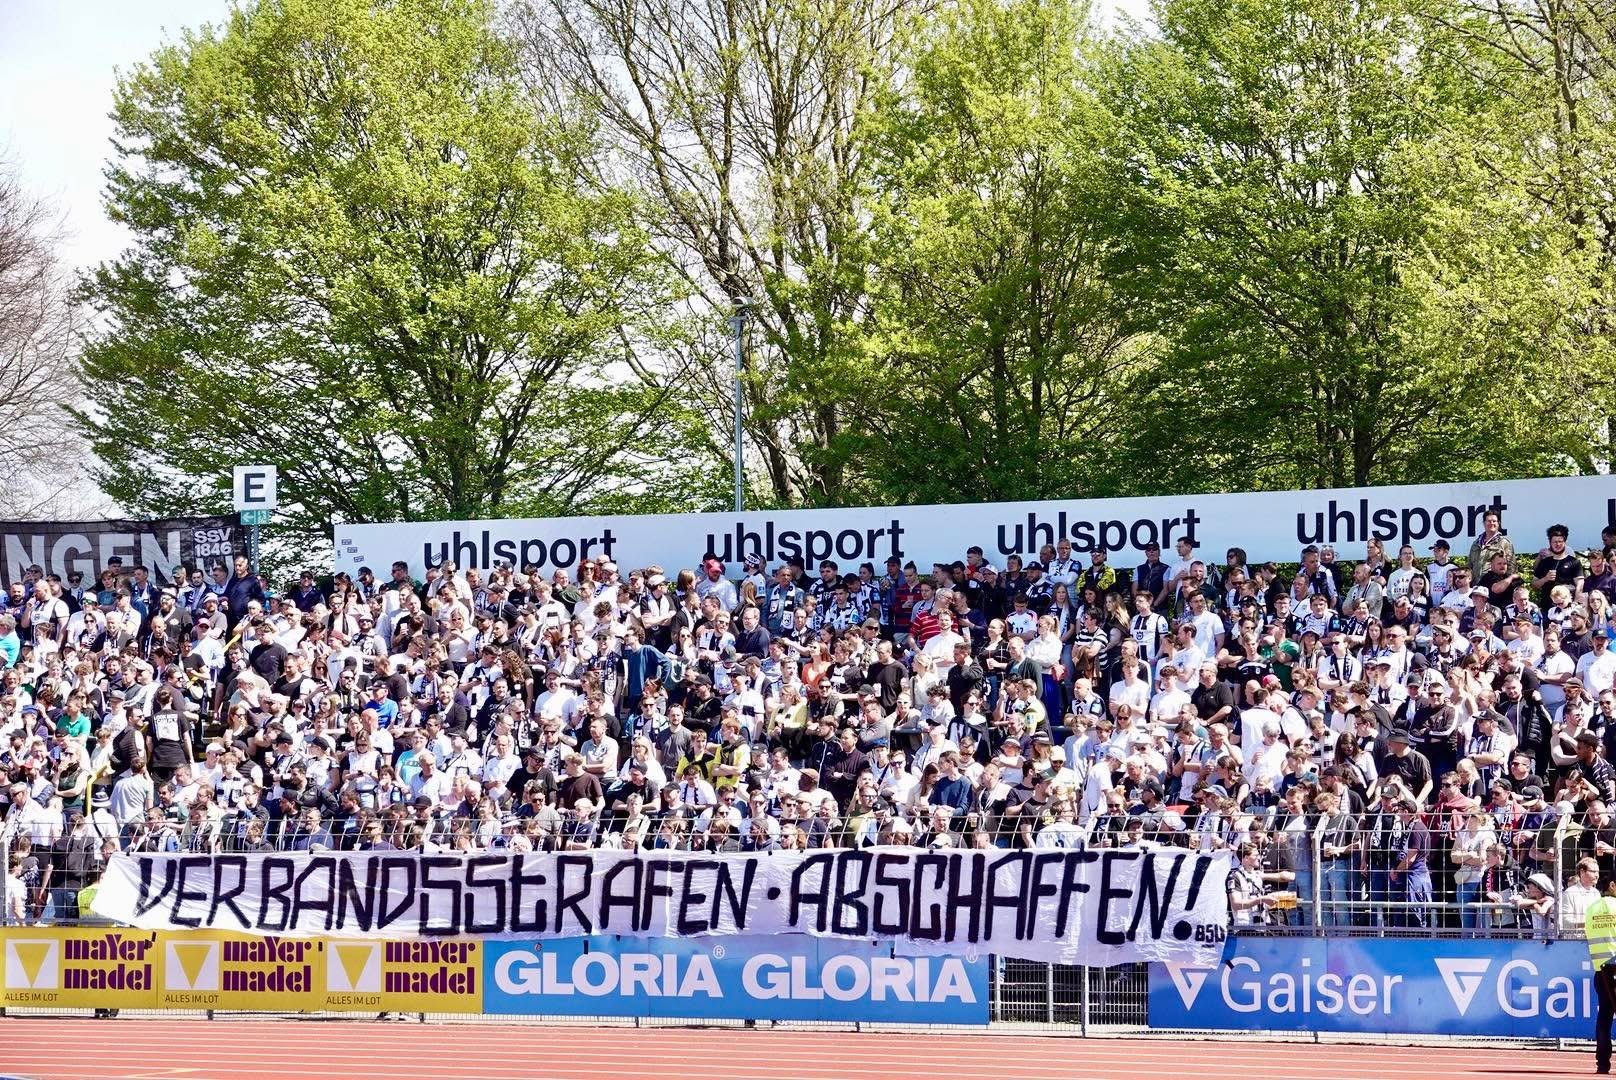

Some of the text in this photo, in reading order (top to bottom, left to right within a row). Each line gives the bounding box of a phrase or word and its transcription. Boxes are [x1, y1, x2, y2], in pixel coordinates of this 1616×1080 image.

[244, 473, 266, 503] E
[997, 509, 1201, 555] uhlsport
[1297, 495, 1507, 545] uhlsport
[194, 528, 231, 543] SSV
[194, 542, 232, 557] 1846
[424, 529, 616, 572] uhlsport
[707, 520, 905, 570] uhlsport
[0, 531, 181, 592] NGEN
[789, 850, 1213, 945] ABSCHAFFEN!
[64, 964, 151, 990] madel
[223, 965, 311, 992] madel
[385, 967, 475, 994] madel
[1221, 956, 1402, 1016] Gaiser
[1497, 959, 1616, 1019] Gai
[5, 993, 59, 1002] ALLES IM LOT
[165, 994, 219, 1003] ALLES IM LOT
[326, 996, 381, 1005] ALLES IM LOT
